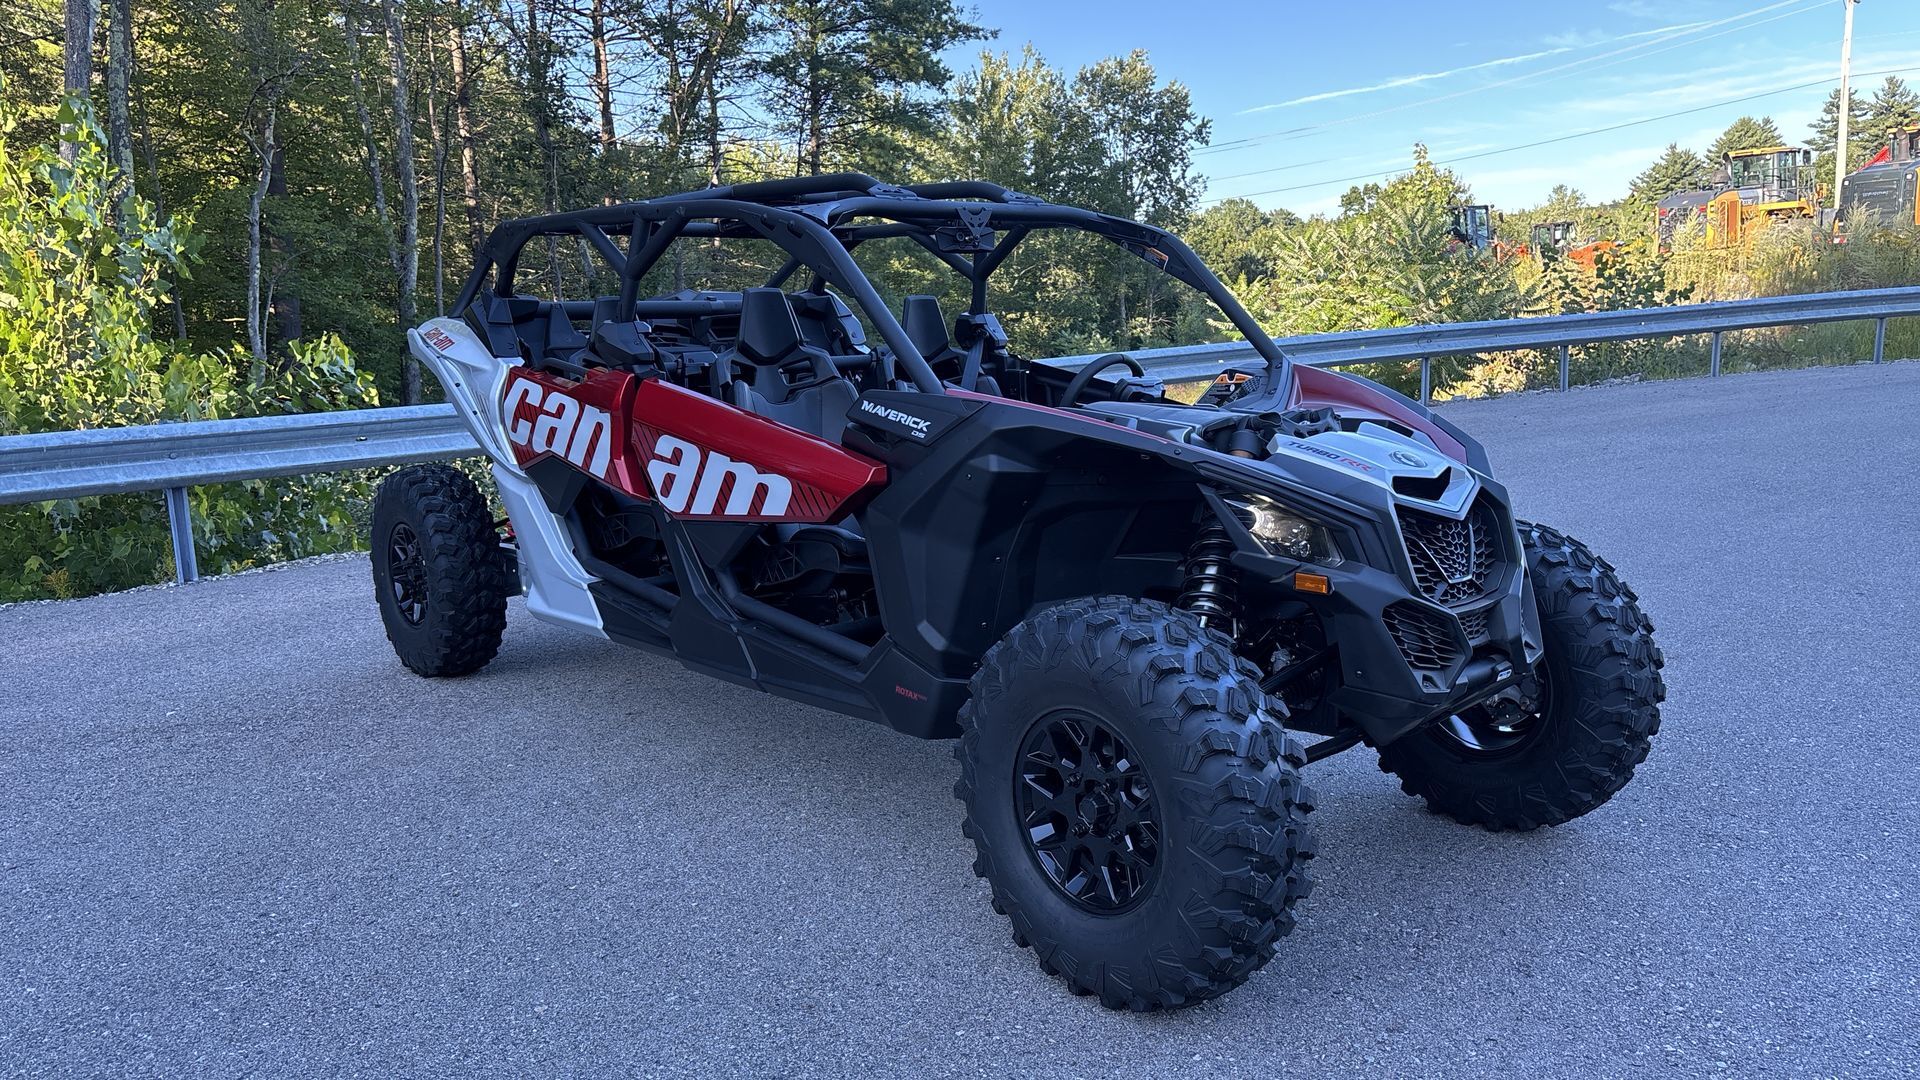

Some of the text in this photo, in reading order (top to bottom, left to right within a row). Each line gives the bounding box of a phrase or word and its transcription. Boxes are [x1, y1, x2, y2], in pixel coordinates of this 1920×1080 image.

[861, 400, 932, 432] MAVERICK
[503, 376, 793, 517] can am
[1288, 440, 1341, 460] TURBO
[895, 685, 919, 701] ROTAX
